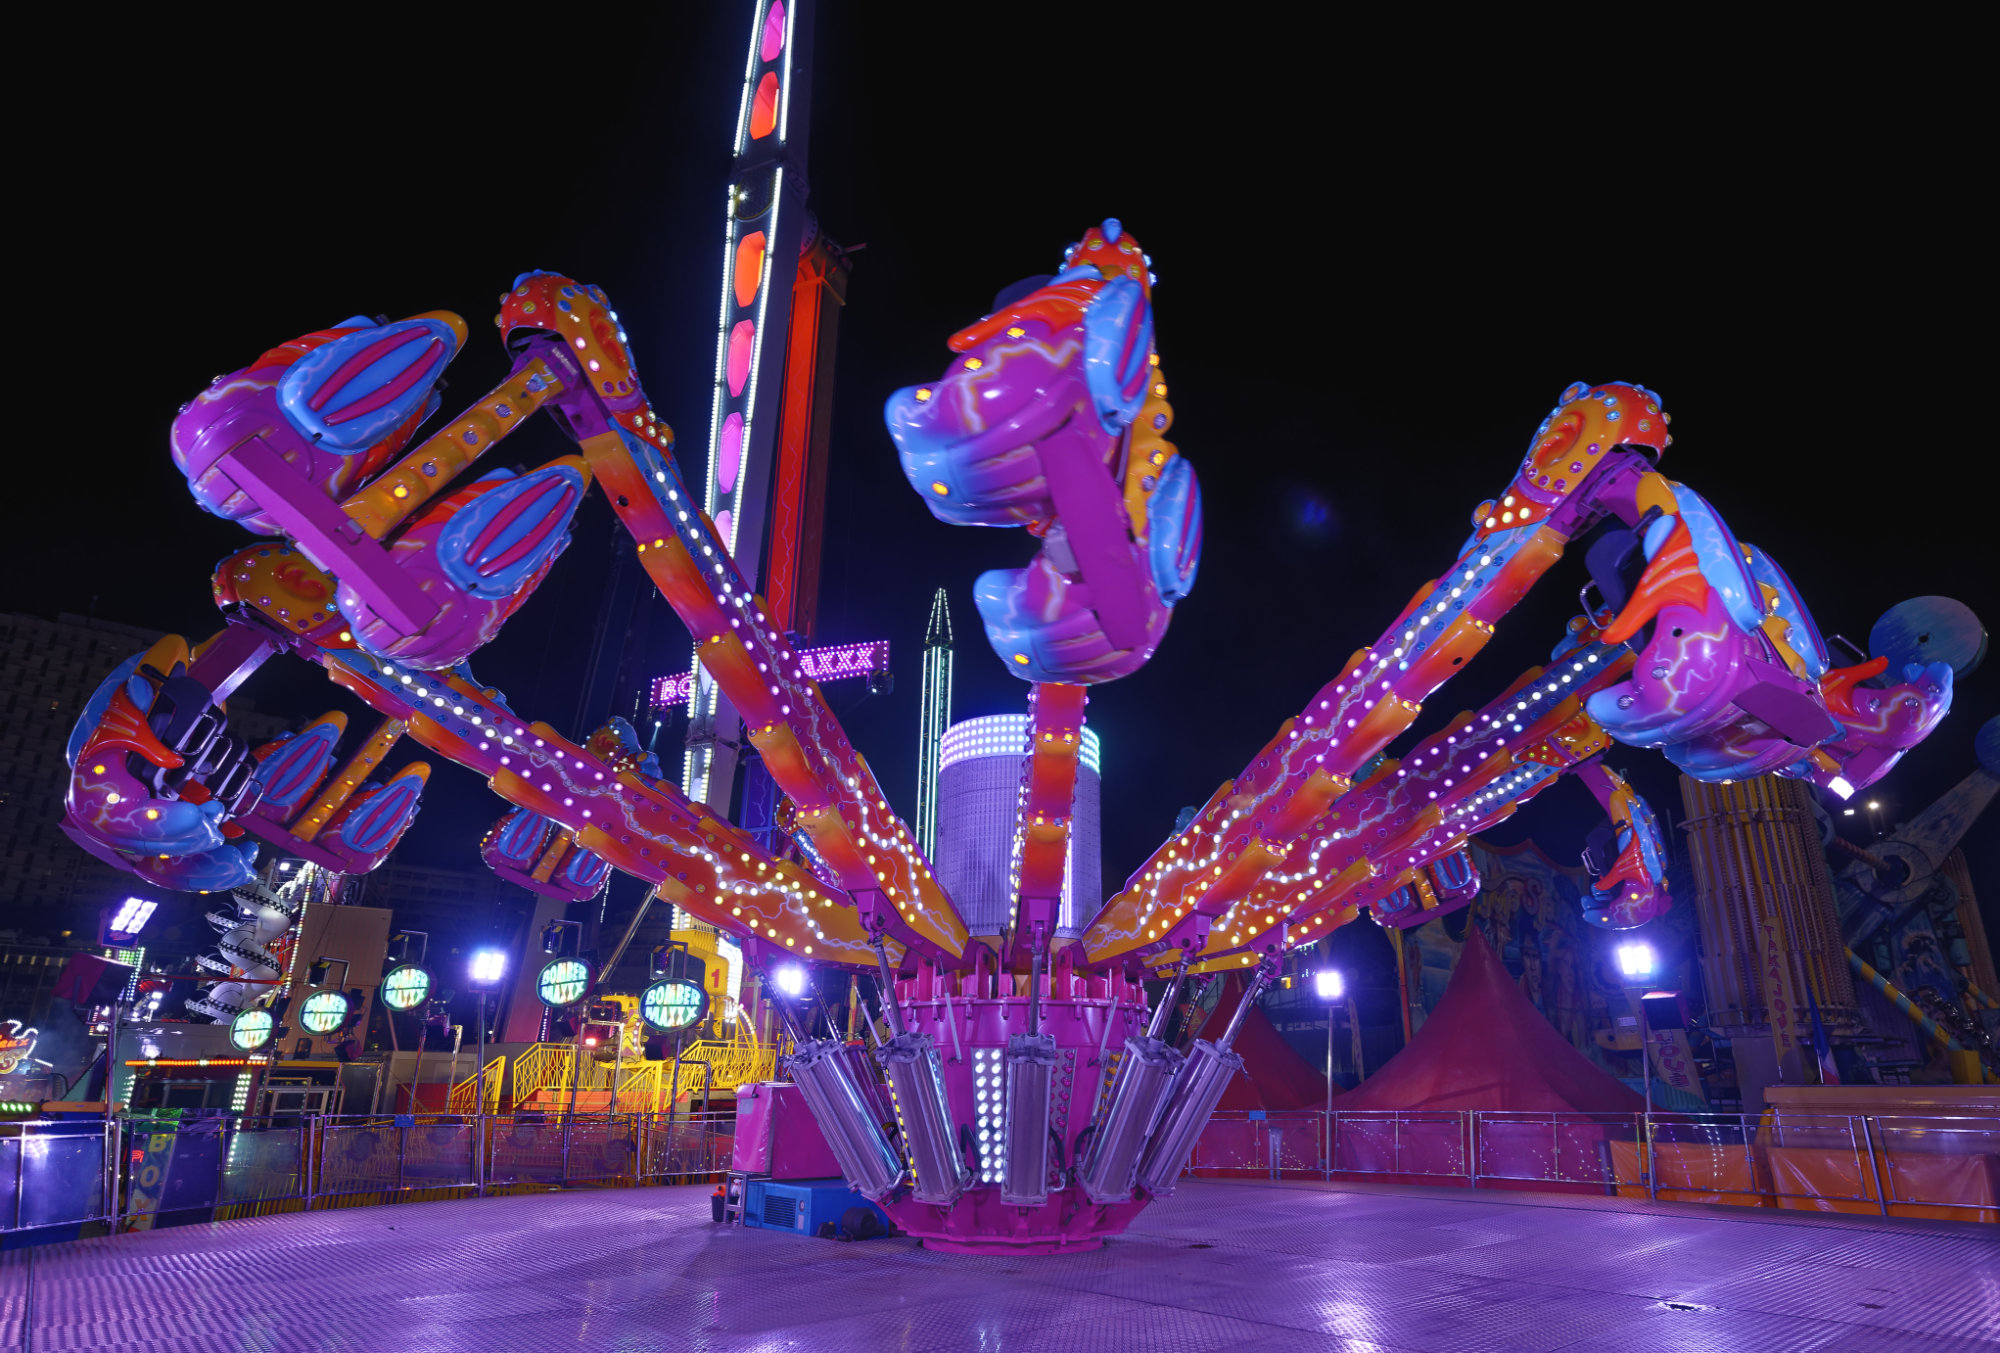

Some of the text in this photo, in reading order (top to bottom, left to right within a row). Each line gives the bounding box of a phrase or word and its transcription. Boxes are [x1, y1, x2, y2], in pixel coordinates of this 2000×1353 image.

[711, 968, 720, 988] 1
[645, 984, 701, 1005] BOMBER
[645, 1005, 698, 1027] MAXXX
